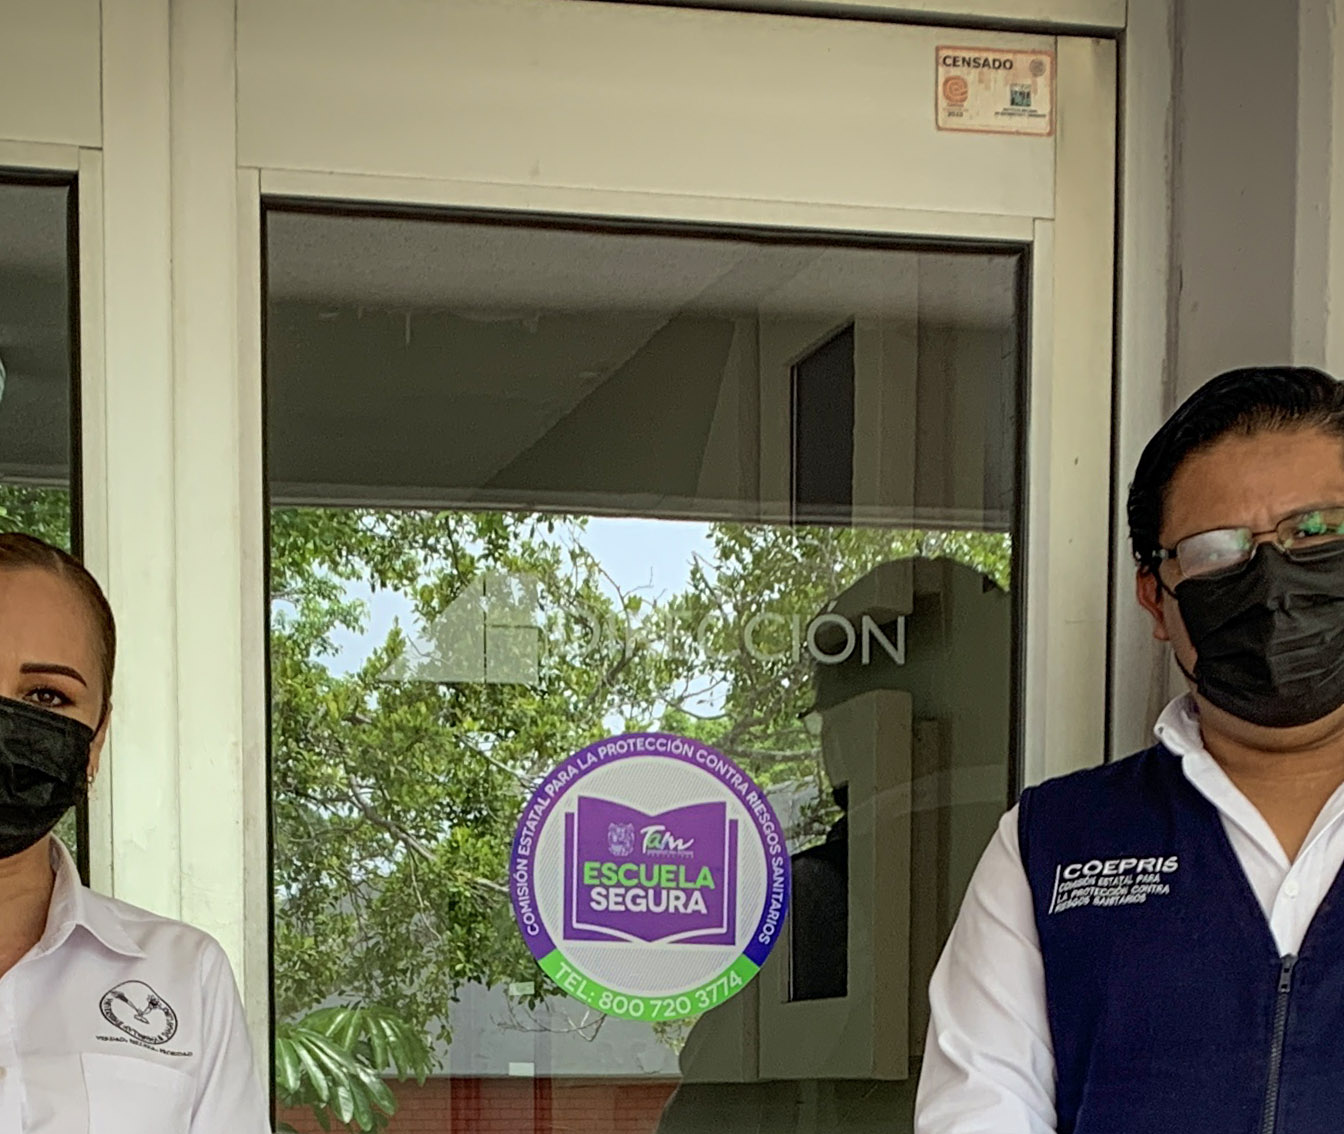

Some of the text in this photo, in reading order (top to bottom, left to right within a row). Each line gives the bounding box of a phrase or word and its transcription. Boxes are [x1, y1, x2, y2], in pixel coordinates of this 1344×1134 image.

[942, 55, 1014, 70] CENSADO
[517, 736, 786, 946] COMISIÓN ESTATAL PARA LA PROTECCIÓN CONTRA RIESGOS SANITARIOS
[583, 861, 716, 889] ESCUELA
[1063, 856, 1179, 879] COEPRIS
[590, 888, 708, 914] SEGURA
[555, 962, 743, 1019] TEL: 800 720 3774
